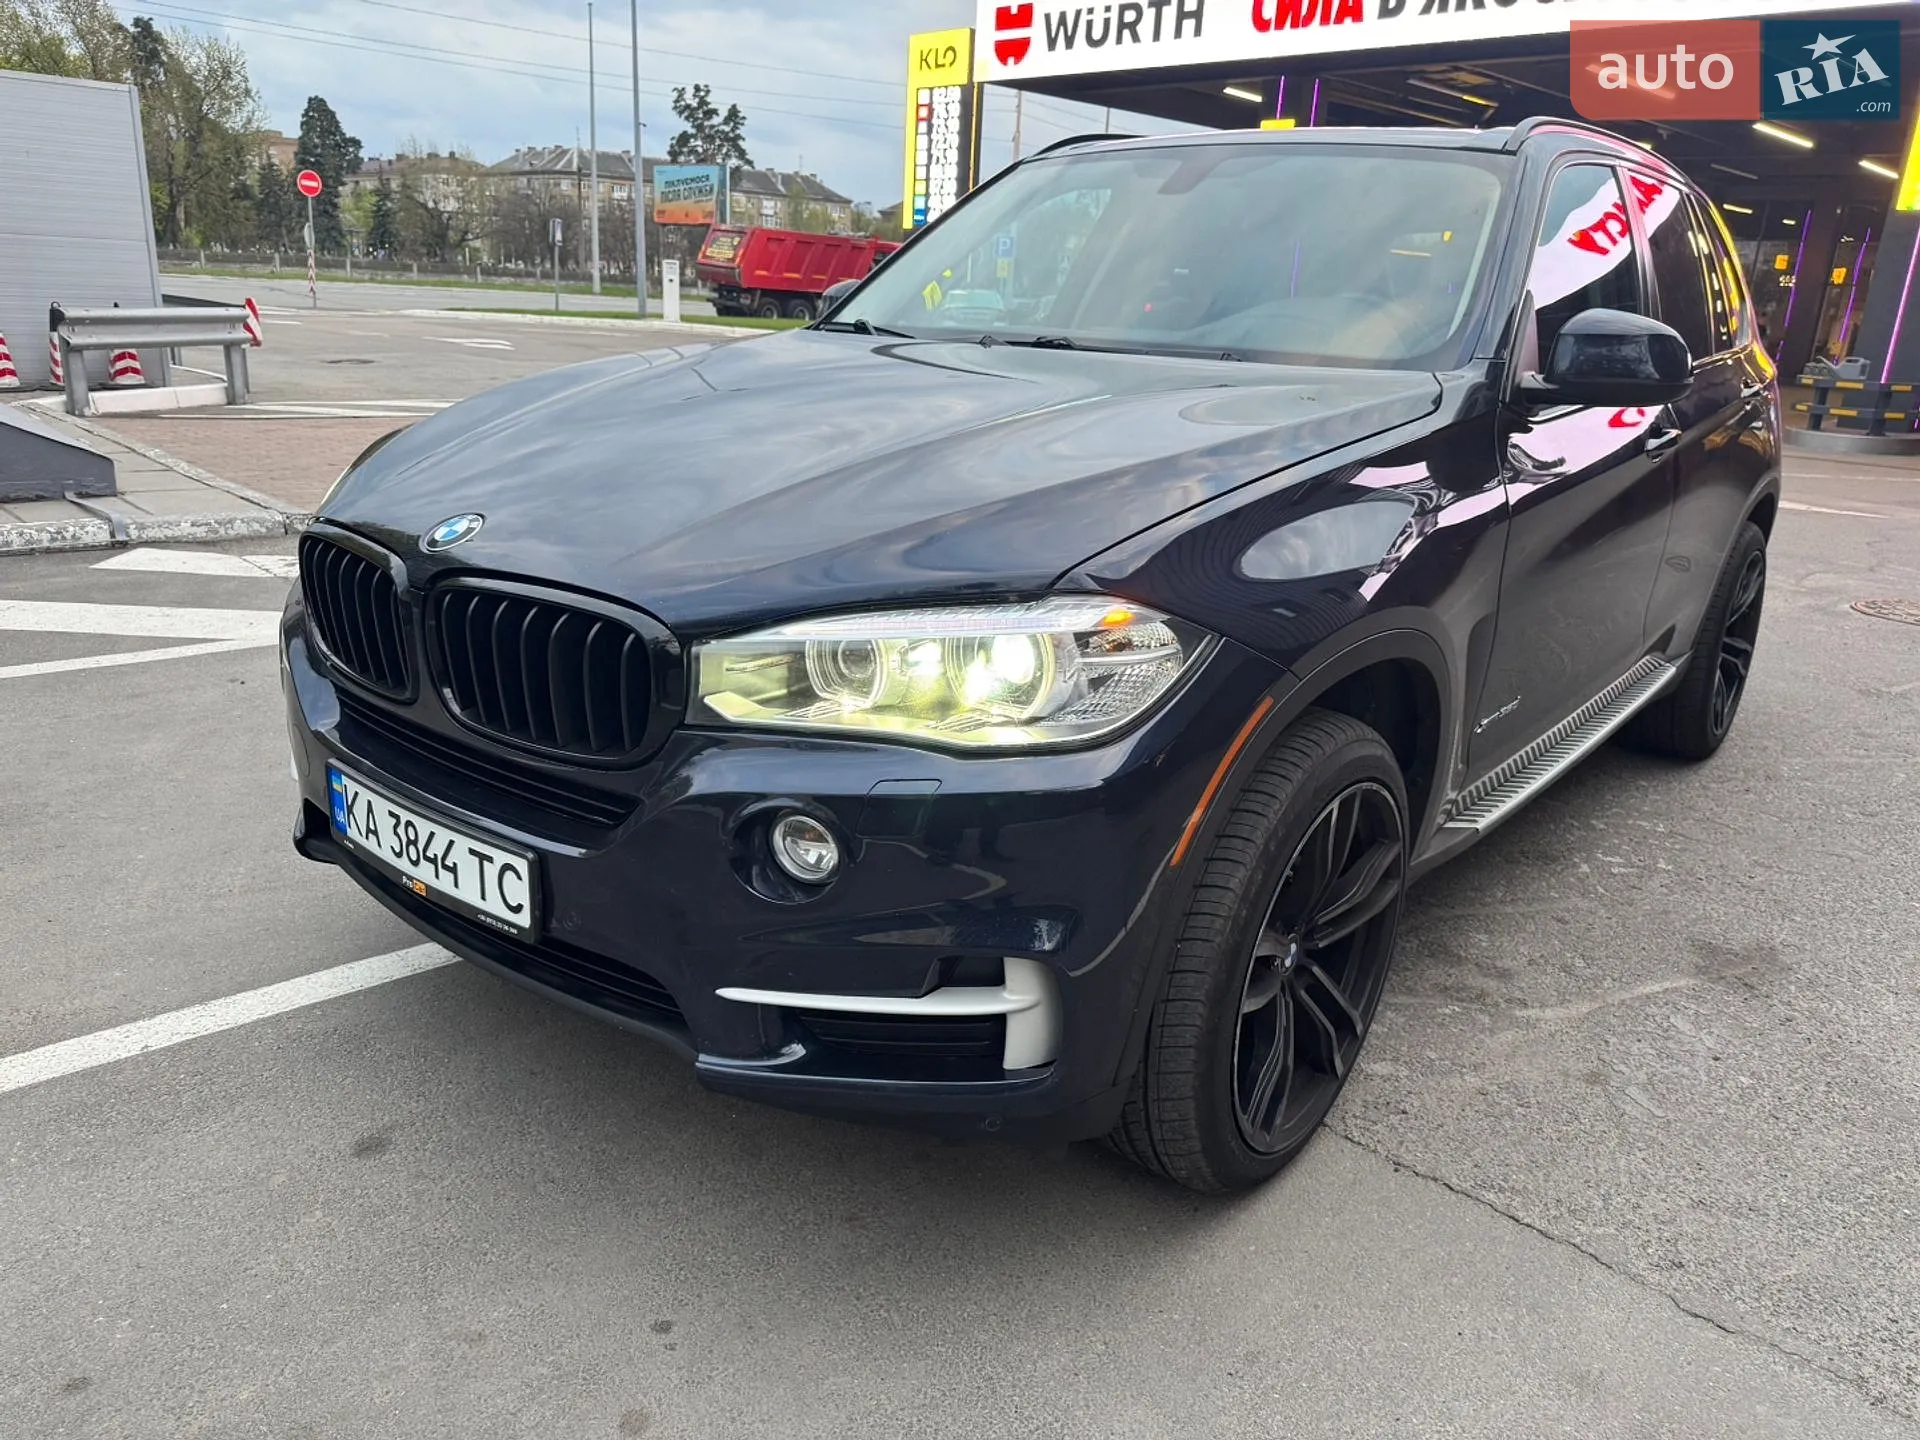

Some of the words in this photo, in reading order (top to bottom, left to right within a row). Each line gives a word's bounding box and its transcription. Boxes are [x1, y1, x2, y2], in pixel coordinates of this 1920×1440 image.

[1044, 0, 1205, 52] WÜRTH
[919, 45, 957, 71] KLO
[343, 783, 383, 849] KA
[387, 809, 460, 890] 3844
[468, 846, 524, 915] TC
